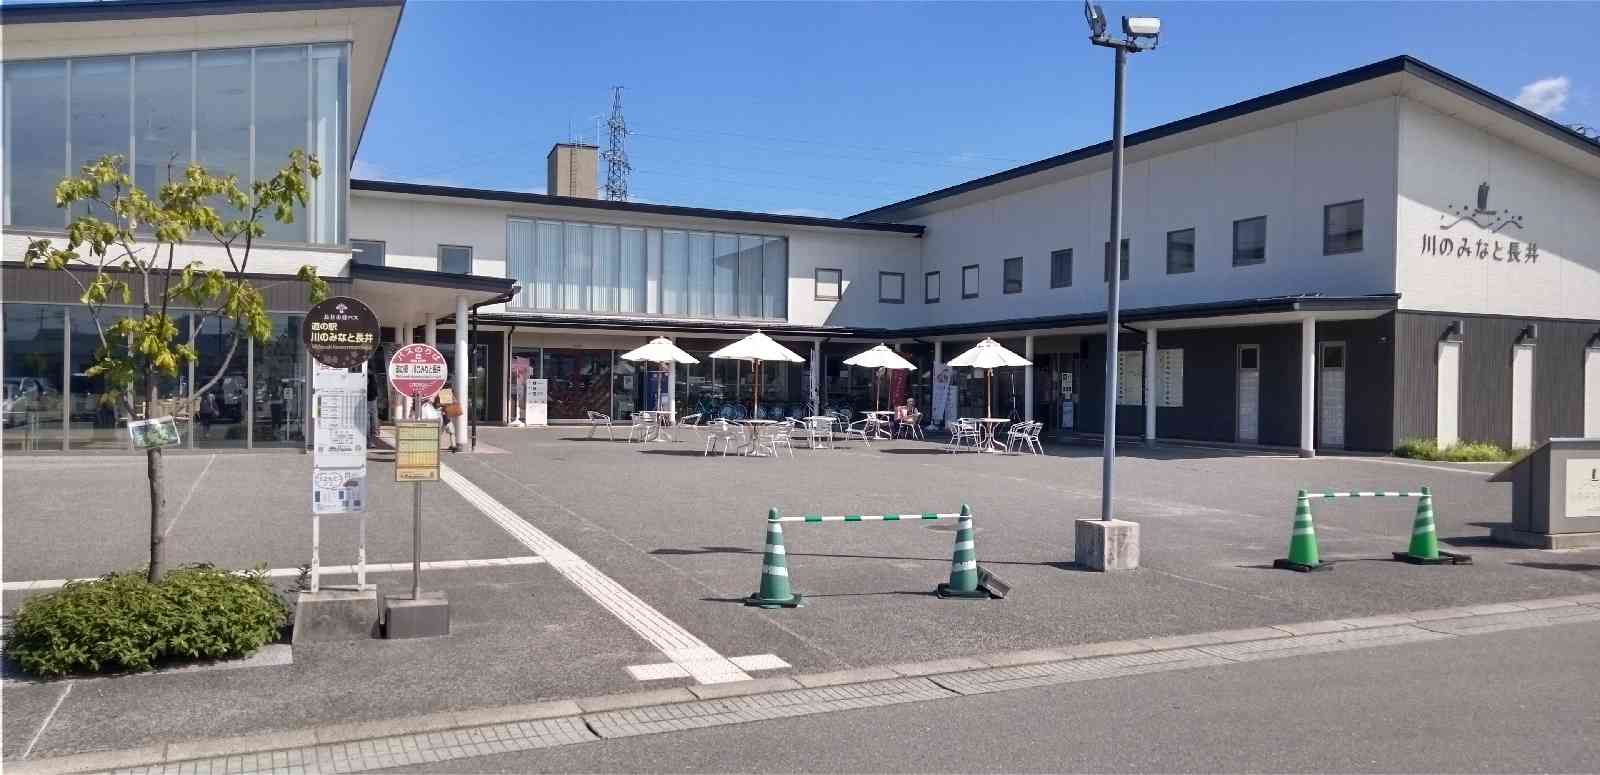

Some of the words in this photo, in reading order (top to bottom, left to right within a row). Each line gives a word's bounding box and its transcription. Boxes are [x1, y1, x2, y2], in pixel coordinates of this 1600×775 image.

[1421, 234, 1540, 264] 川のみなと長井
[311, 322, 338, 331] 道の駅
[311, 332, 373, 344] 川のみなと長井
[397, 346, 440, 361] バスのりば
